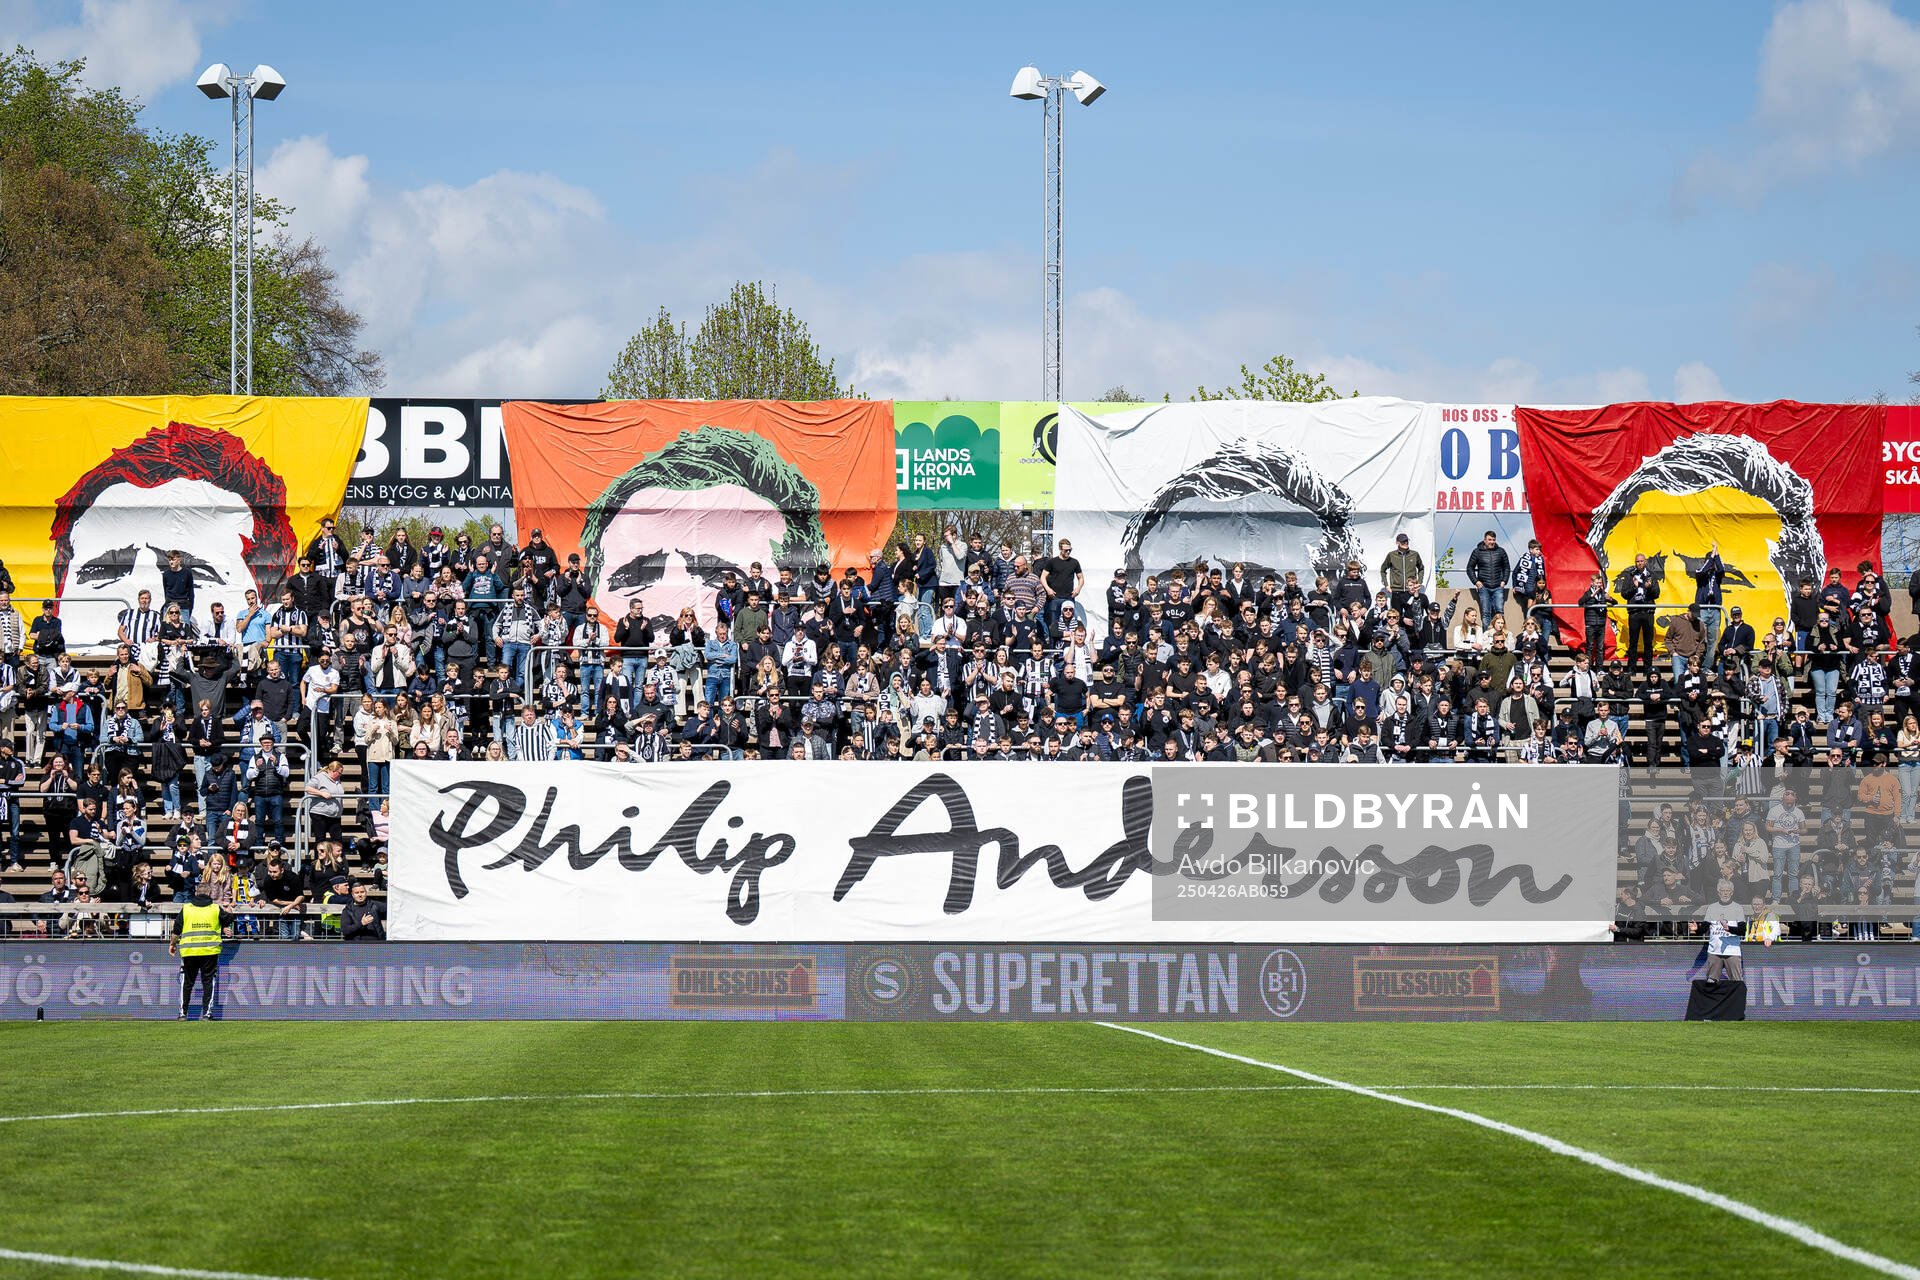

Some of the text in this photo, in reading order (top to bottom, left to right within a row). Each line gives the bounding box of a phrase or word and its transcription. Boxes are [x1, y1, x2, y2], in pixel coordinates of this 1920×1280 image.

[1442, 409, 1468, 422] HOS
[1472, 409, 1499, 422] OSS
[913, 448, 971, 462] LANDS
[913, 463, 976, 476] KRONA
[1885, 466, 1920, 485] SKÅ
[380, 485, 428, 499] BYGG
[434, 485, 446, 499] &
[451, 485, 513, 499] MONTA
[913, 477, 951, 490] HEM
[1436, 486, 1485, 510] BÅDE
[1491, 486, 1515, 510] PÅ
[1166, 609, 1186, 617] POLO
[428, 772, 1574, 926] Philip Andersson
[67, 965, 105, 1006] &
[117, 951, 474, 1006] ÅTRVINNING
[677, 969, 790, 994] OHLSSONS
[932, 952, 1239, 1014] SUPERETTAN
[1361, 971, 1473, 995] OHLSSONS
